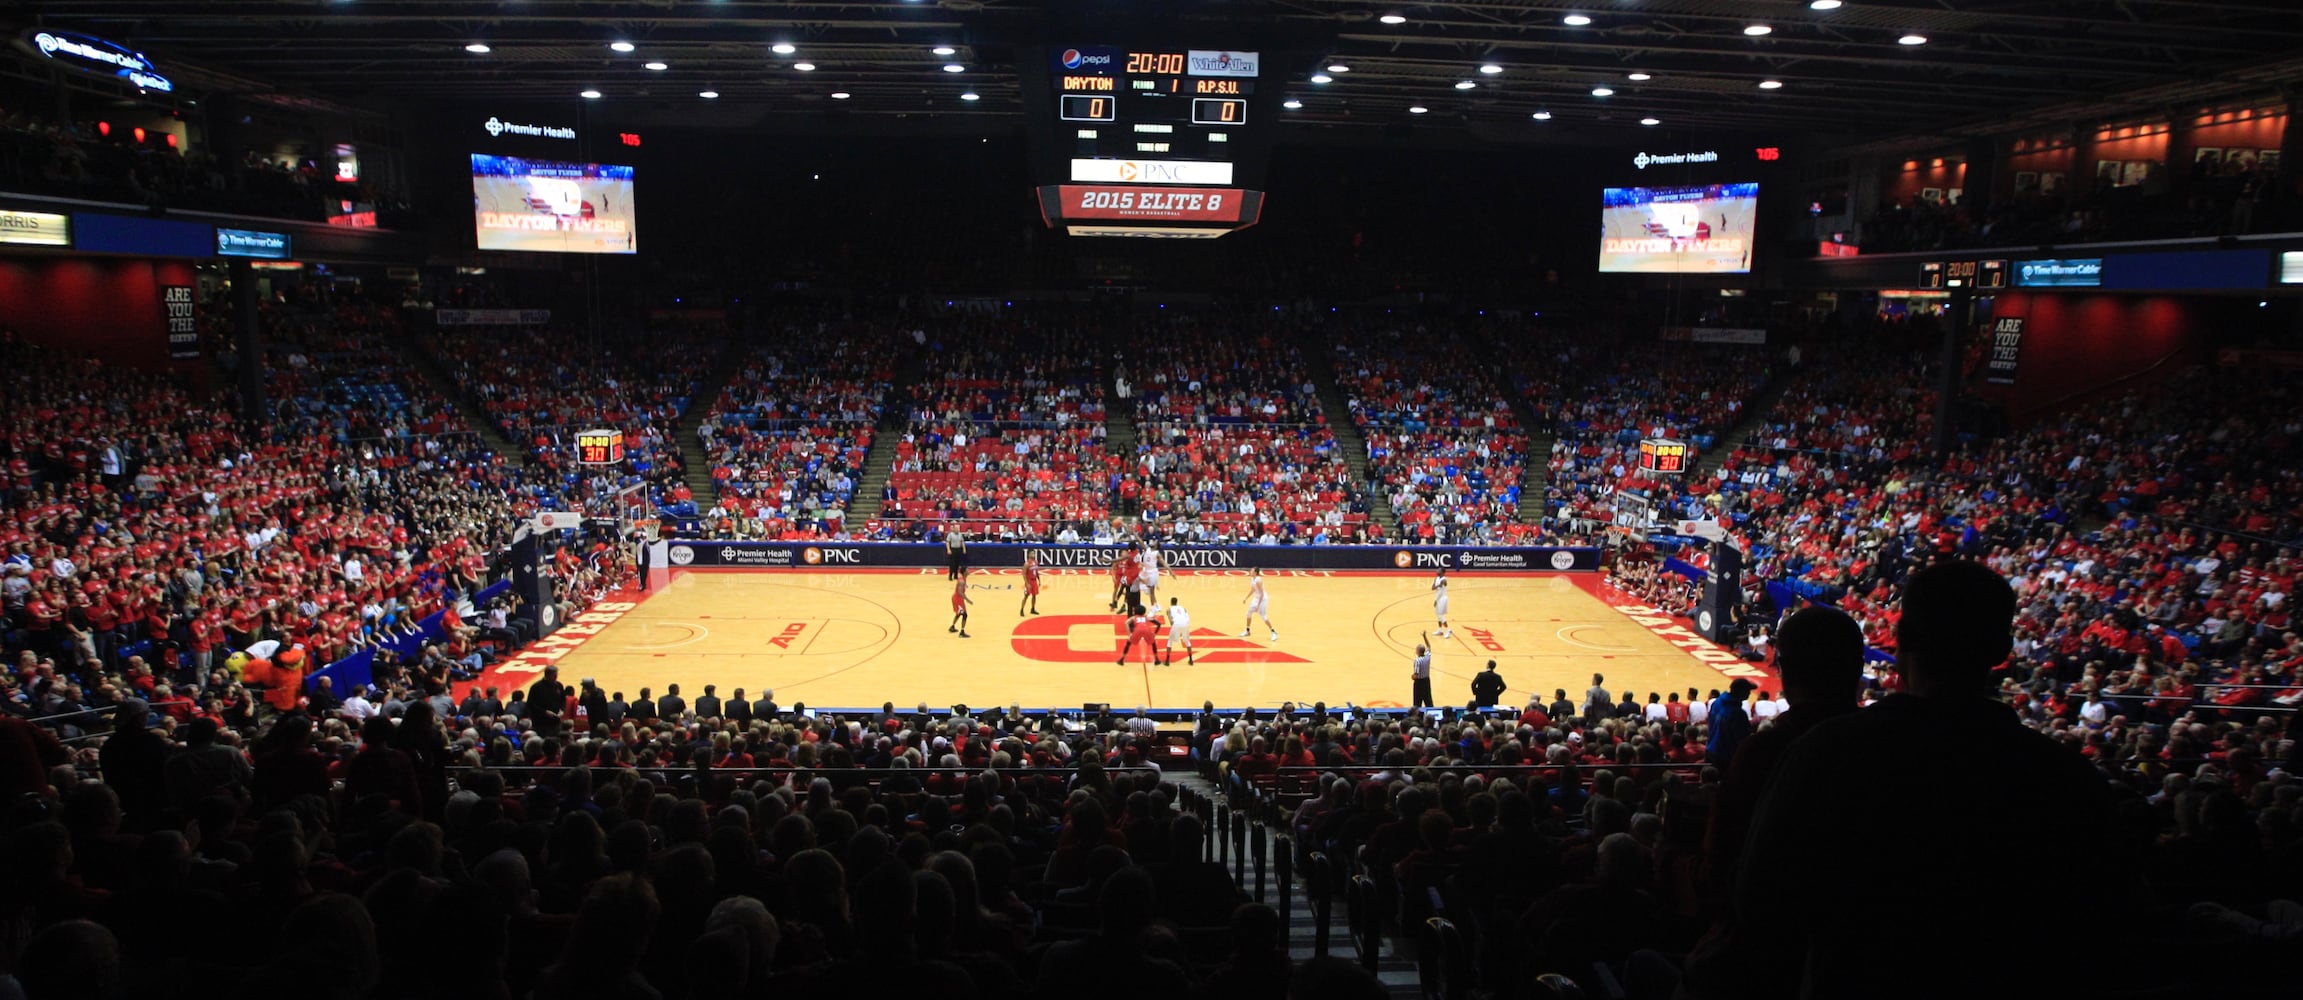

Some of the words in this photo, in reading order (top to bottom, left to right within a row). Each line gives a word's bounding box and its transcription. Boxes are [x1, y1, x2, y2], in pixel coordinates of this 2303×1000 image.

[55, 36, 82, 56] Time
[1081, 54, 1110, 65] pepsi
[1127, 53, 1184, 74] 20:00
[1192, 57, 1226, 72] White
[1226, 57, 1255, 72] Allen
[1063, 76, 1113, 91] DAYTON
[1171, 79, 1179, 93] 1
[1196, 80, 1239, 94] A.P.S.U.
[1089, 98, 1104, 119] 0
[1220, 101, 1235, 121] 0
[504, 122, 542, 137] Premier
[544, 126, 576, 140] Health
[1154, 143, 1170, 152] OUT
[1650, 153, 1685, 165] Premier
[1686, 151, 1718, 163] Health
[1144, 163, 1187, 181] PNC
[1081, 191, 1132, 210] 2015
[1138, 193, 1205, 211] ELITE
[1206, 194, 1222, 211] 8
[481, 212, 558, 231] DAYTON
[559, 218, 627, 233] FLYERS
[229, 234, 246, 246] Time
[245, 235, 267, 247] Warner
[266, 237, 284, 248] Cable
[1605, 238, 1672, 253] DAYTON
[1674, 237, 1744, 253] FLYERS
[1947, 262, 1976, 277] 20:00
[2034, 265, 2051, 275] Time
[2050, 264, 2078, 275] Warner
[2077, 264, 2101, 275] Cable
[1931, 273, 1940, 288] 0
[1992, 271, 2001, 287] 0
[165, 287, 191, 302] ARE
[167, 302, 193, 317] YOU
[169, 317, 195, 332] THE
[1995, 318, 2023, 332] ARE
[1995, 332, 2021, 346] YOU
[1993, 346, 2019, 360] THE
[580, 436, 609, 447] 20:00
[585, 447, 605, 462] 30
[1656, 445, 1684, 457] 20:00
[1659, 456, 1679, 470] 30
[672, 550, 692, 561] Kroger
[736, 549, 764, 558] Premier
[767, 549, 793, 558] Health
[823, 549, 860, 563] PNC
[1164, 550, 1237, 567] DAYTON
[1416, 553, 1451, 567] PNC
[1473, 554, 1500, 562] Premier
[1500, 554, 1523, 562] Health
[1553, 556, 1573, 567] Kroger
[1193, 568, 1337, 577] COURT
[494, 602, 637, 674] FLYERS
[1614, 605, 1769, 678] DAYTON
